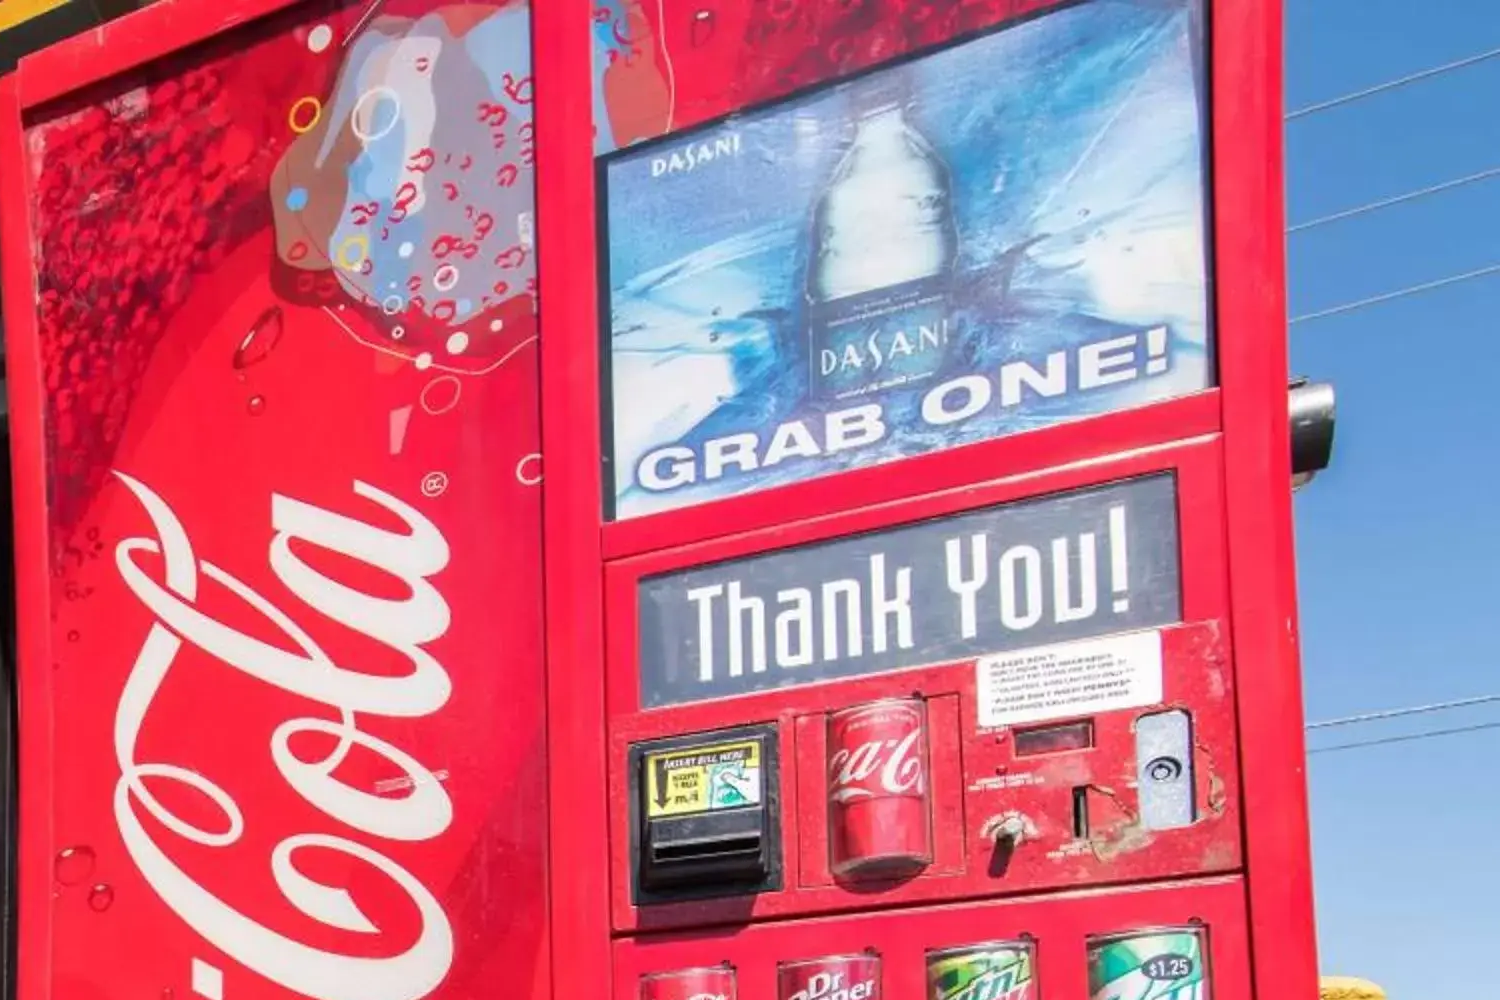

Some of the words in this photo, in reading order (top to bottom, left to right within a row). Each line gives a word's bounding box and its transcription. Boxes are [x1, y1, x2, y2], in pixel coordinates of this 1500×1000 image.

[651, 133, 740, 177] DASANI
[821, 319, 949, 376] DASANI
[638, 403, 886, 491] GRAB
[922, 326, 1168, 426] ONE!
[687, 552, 915, 682] Thank
[808, 971, 845, 1000] Dr
[1149, 959, 1190, 977] $1.25
